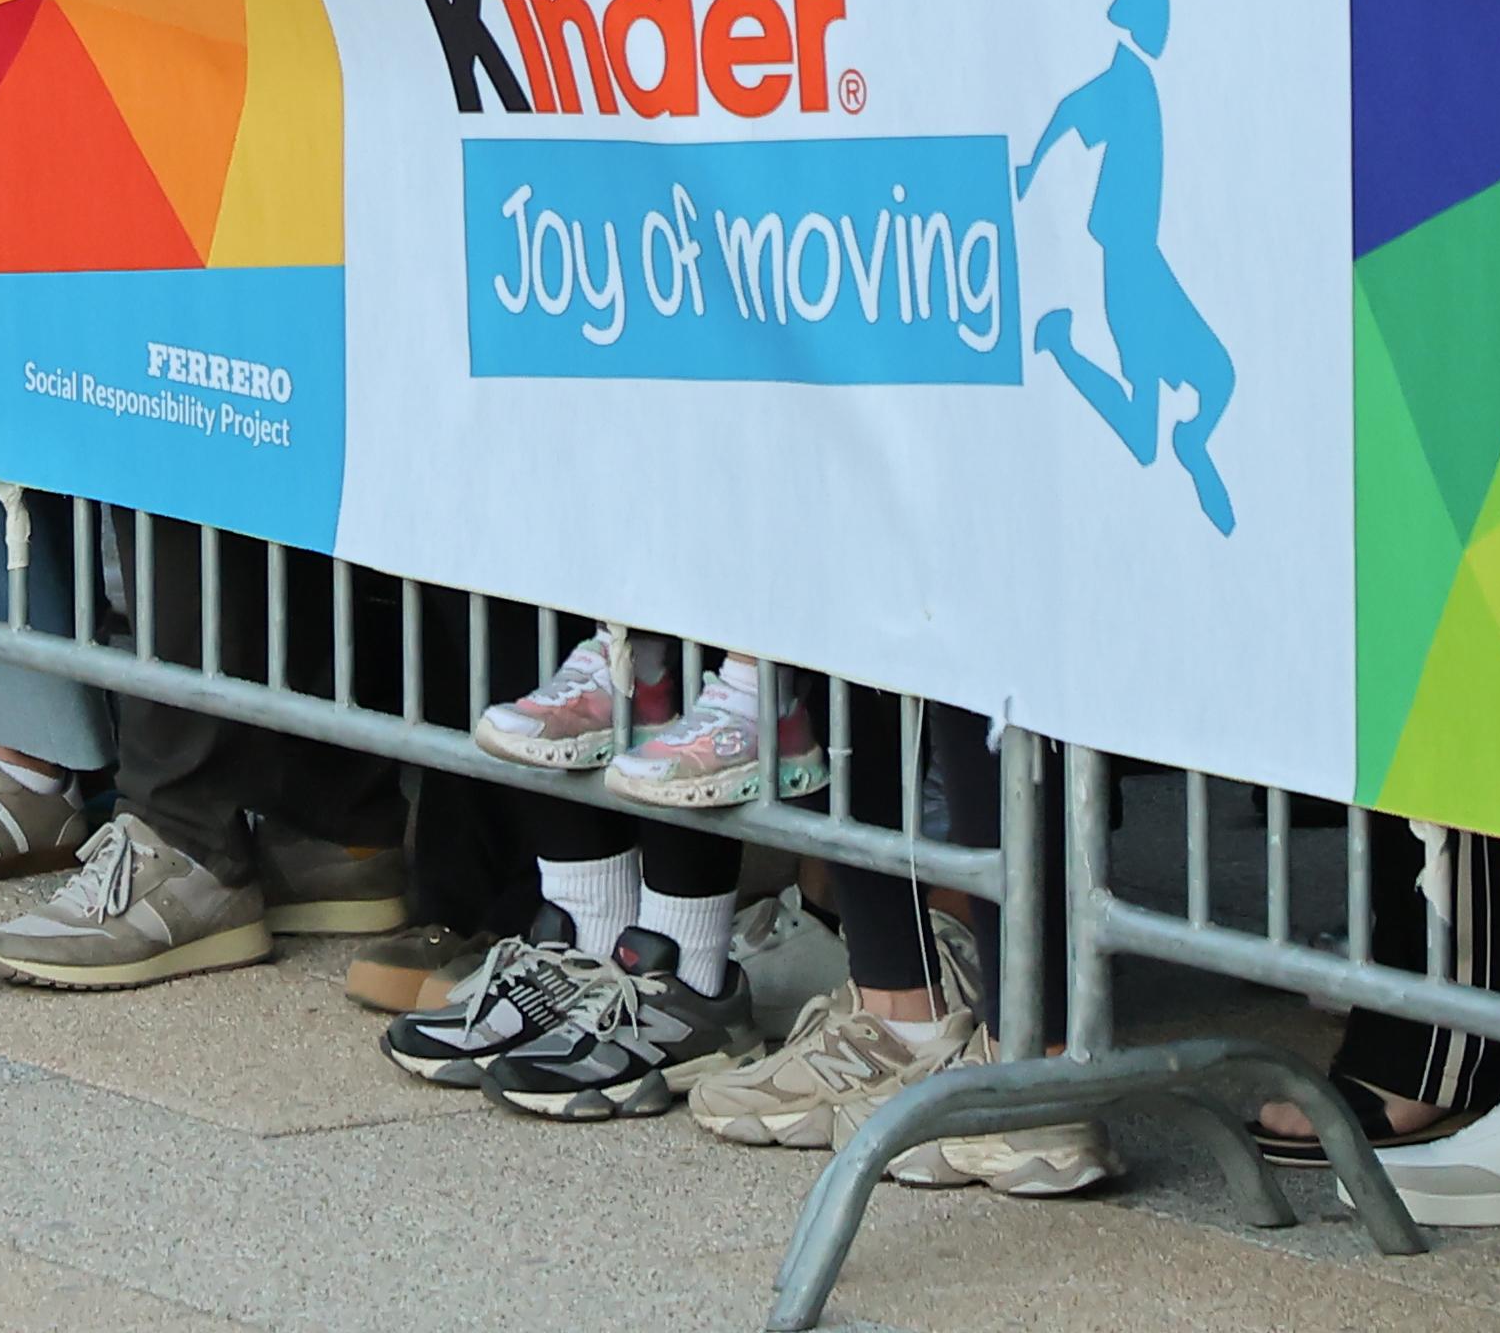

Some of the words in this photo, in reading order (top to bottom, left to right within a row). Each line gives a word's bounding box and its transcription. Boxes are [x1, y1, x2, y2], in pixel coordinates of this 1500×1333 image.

[494, 184, 626, 345] Joy
[641, 182, 702, 317] of
[714, 183, 1000, 353] moving
[24, 361, 77, 402] Social
[82, 373, 216, 436] Responsibility
[220, 403, 291, 447] Project
[147, 342, 293, 404] FERRERO
